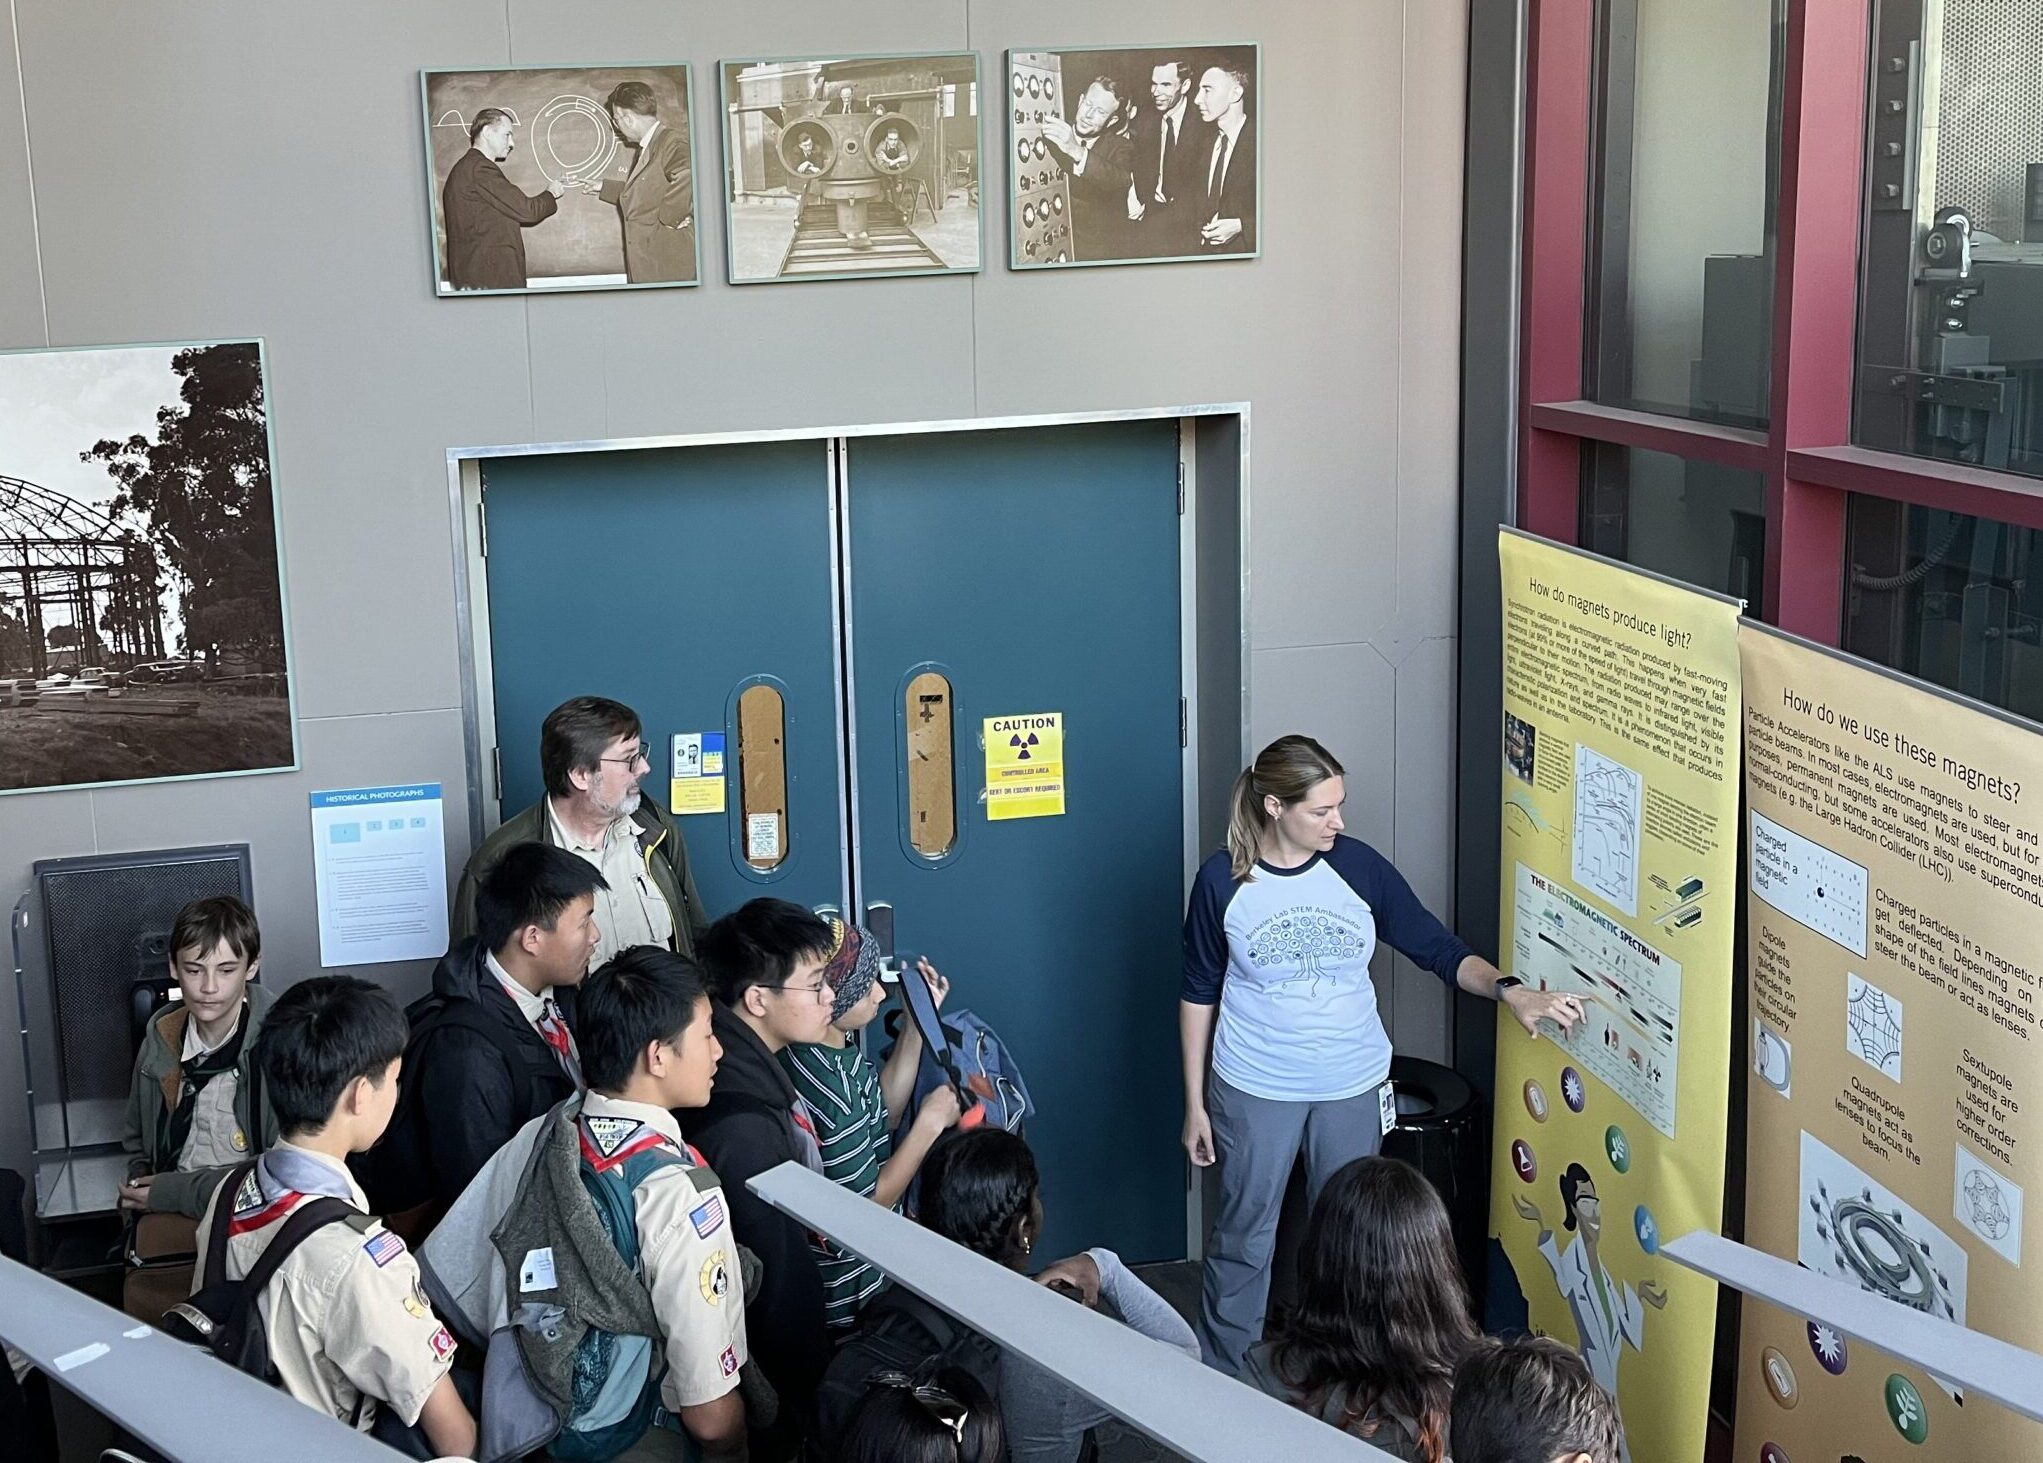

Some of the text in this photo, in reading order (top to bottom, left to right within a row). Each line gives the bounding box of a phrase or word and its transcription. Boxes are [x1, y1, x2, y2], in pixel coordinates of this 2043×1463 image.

[1529, 577, 1691, 649] How do magnets produce light?
[993, 717, 1055, 732] CAUTION
[1783, 687, 2020, 804] How do we use these magnets?
[326, 789, 425, 803] HISTORICAL PHOTOGRAPHS
[1035, 784, 1060, 792] REQUIRED
[1775, 735, 1804, 758] beams.
[1807, 750, 1815, 763] In
[1818, 757, 1840, 774] most
[1842, 768, 1871, 790] cases,
[1874, 782, 1948, 824] electromagnets
[1951, 817, 1967, 832] are
[1970, 826, 1998, 850] used,
[2002, 838, 2020, 858] but
[2023, 847, 2039, 866] for
[1777, 720, 1829, 752] Accelerators
[1834, 744, 1849, 761] like
[1854, 754, 1868, 769] the
[1872, 762, 1892, 780] ALS
[1897, 775, 1915, 790] use
[1920, 785, 1962, 812] magnets
[1968, 804, 1978, 819] to
[1983, 813, 2010, 833] steer
[2016, 828, 2037, 846] and
[1786, 760, 1832, 788] permanent
[1837, 783, 1876, 808] magnets
[1882, 803, 1897, 818] are
[1903, 812, 1928, 833] used.
[1935, 824, 1959, 848] Most
[1749, 771, 1953, 883] magnets (e.g. the Large Hadron Collider (LHC)).
[1755, 825, 1786, 852] Charged
[1824, 790, 1838, 807] but
[1842, 801, 1867, 821] some
[1871, 815, 1929, 851] accelerators
[1933, 845, 1953, 863] also
[1958, 857, 1976, 874] use
[1755, 858, 1787, 885] magnetic
[1782, 860, 1790, 870] in
[1791, 865, 1797, 874] a
[1245, 906, 1361, 941] Berkeley Lab STEM Ambassador
[1530, 874, 1546, 891] THE
[1547, 881, 1618, 937] ELECTROMAGNETIC
[1619, 931, 1661, 966] SPECTRUM
[1762, 925, 1785, 949] Dipole
[1875, 888, 1916, 919] Charged
[1919, 913, 1959, 943] particles
[1962, 935, 1971, 950] in
[1974, 945, 1980, 956] a
[1984, 950, 2034, 985] magnetic
[1758, 941, 1790, 968] magnets
[1777, 968, 1791, 985] the
[1875, 907, 2031, 1003] get deflected. Depending on
[1875, 923, 2034, 1023] shape of the field lines magnets
[1767, 994, 1796, 1019] circular
[1783, 990, 1795, 1003] on
[1874, 941, 1898, 960] steer
[1900, 953, 1915, 971] the
[1918, 963, 1945, 988] beam
[1947, 983, 1957, 996] or
[1959, 991, 1974, 1008] act
[1976, 1002, 1988, 1016] as
[1991, 1007, 2029, 1040] lenses.
[1956, 1064, 2018, 1112] magnets are
[1962, 1048, 2012, 1090] Sextupole
[1843, 1089, 1912, 1143] magnets act as
[1851, 1076, 1904, 1120] Quadrupole
[1965, 1089, 2005, 1122] used for
[1835, 1097, 1920, 1165] lenses to focus the
[1956, 1097, 2016, 1148] higher order
[1956, 1119, 2012, 1166] corrections.
[1862, 1132, 1890, 1161] beam.
